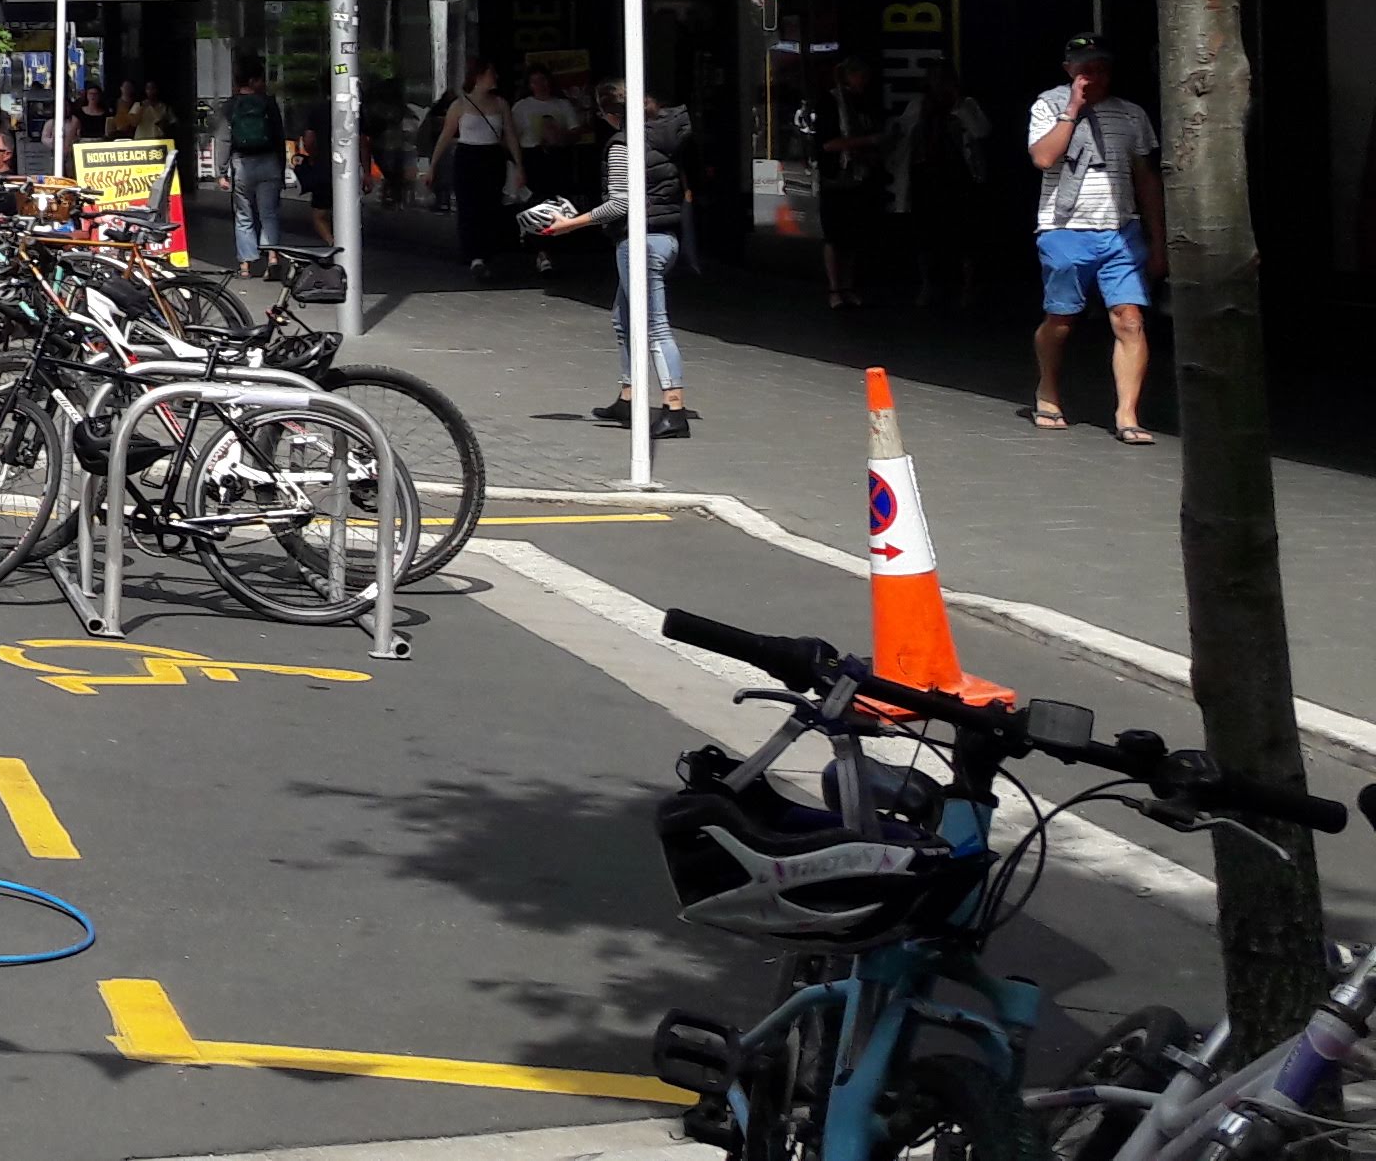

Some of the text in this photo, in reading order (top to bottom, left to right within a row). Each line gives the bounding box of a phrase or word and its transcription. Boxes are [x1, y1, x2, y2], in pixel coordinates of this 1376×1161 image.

[86, 150, 147, 163] NORTH BEACH
[84, 168, 132, 189] MARCH
